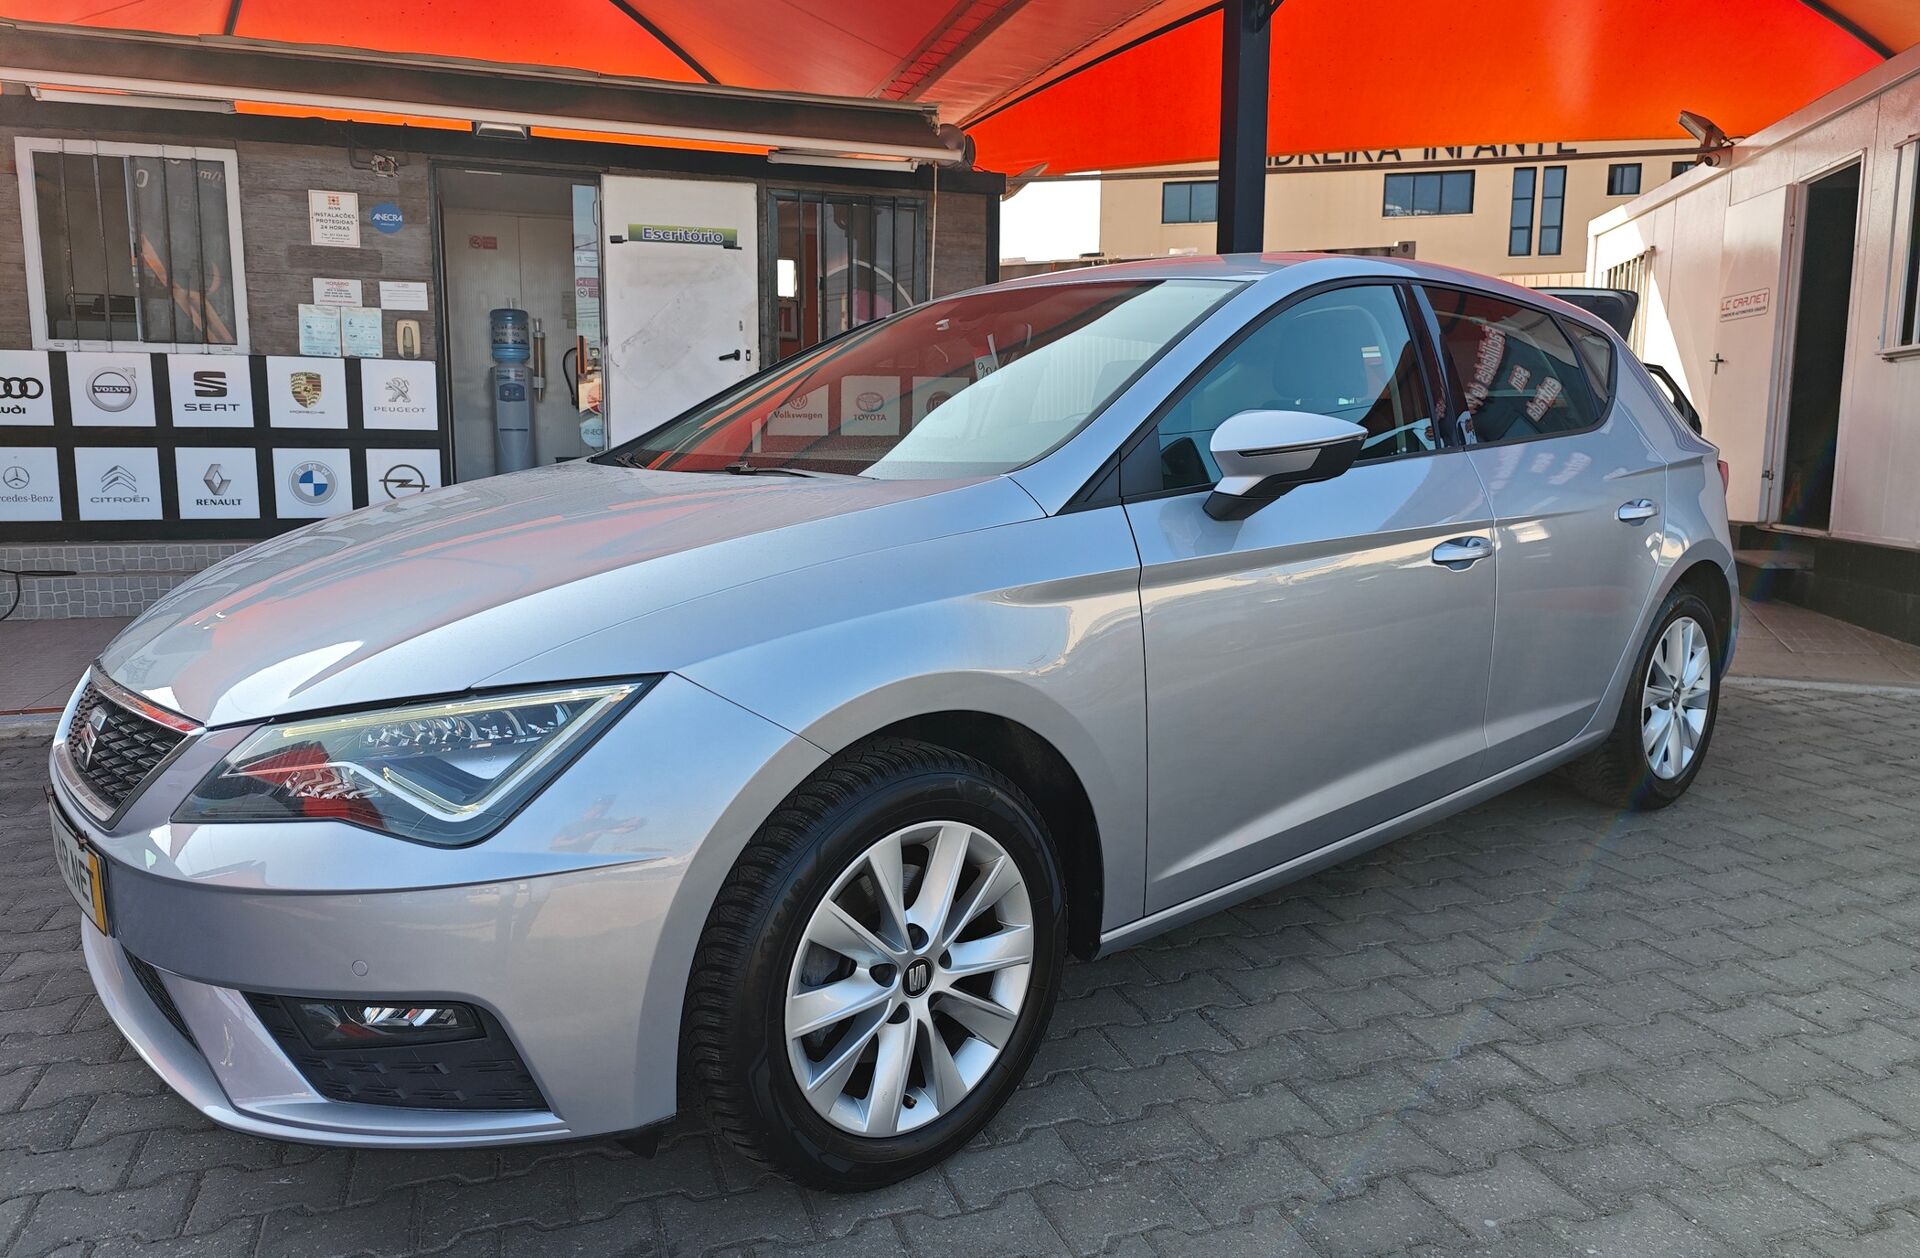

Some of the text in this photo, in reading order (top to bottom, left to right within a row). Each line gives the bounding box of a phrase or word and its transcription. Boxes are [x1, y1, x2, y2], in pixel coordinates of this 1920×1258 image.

[1267, 147, 1402, 167] IDREIRA
[372, 212, 403, 222] ANECRA
[642, 226, 724, 243] Escritório
[0, 404, 26, 414] udi
[184, 403, 240, 412] SEAT
[773, 410, 823, 421] Volkswagen
[853, 413, 886, 422] TOYOTA
[295, 463, 330, 476] BMW
[0, 494, 54, 503] cedes-Benz
[196, 498, 242, 506] RENAULT
